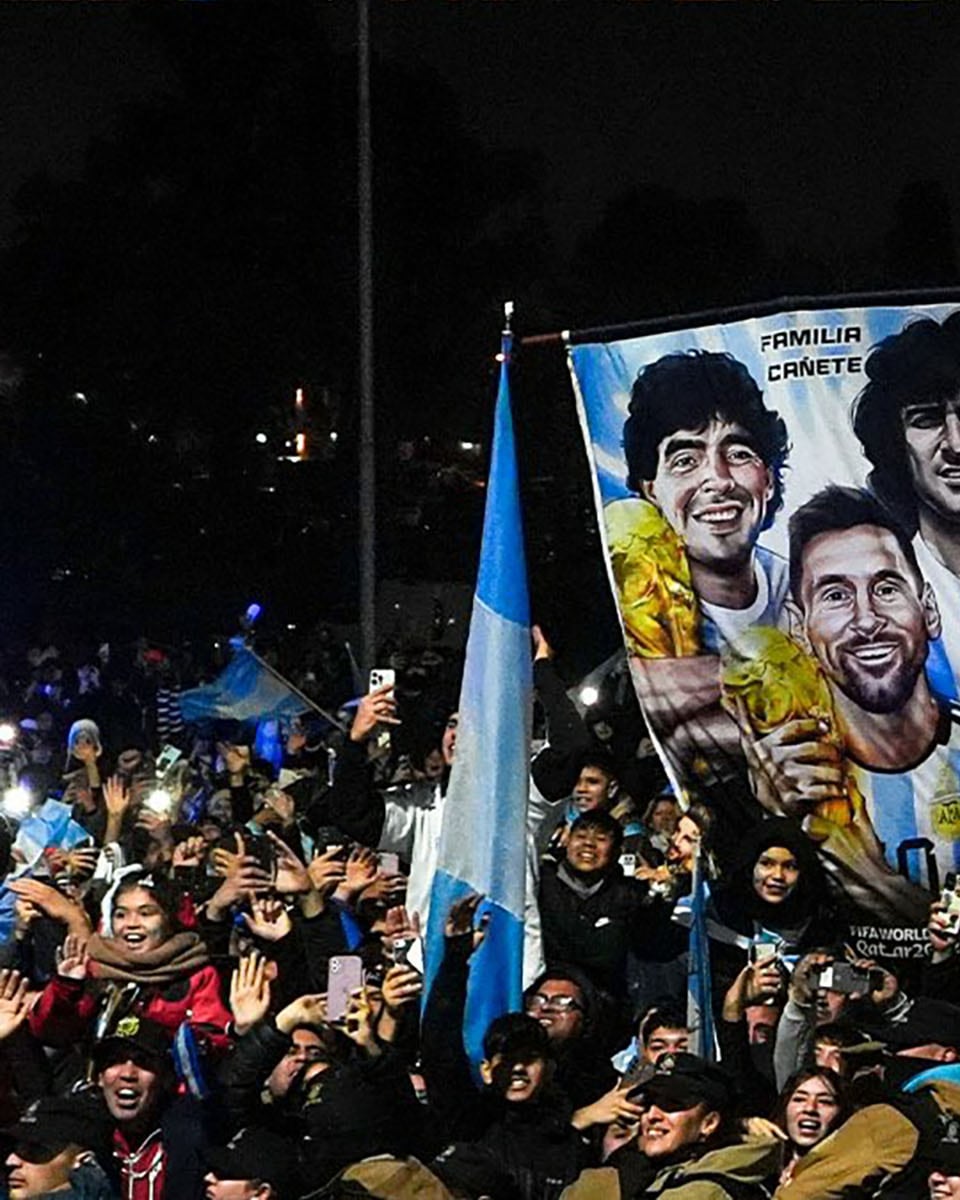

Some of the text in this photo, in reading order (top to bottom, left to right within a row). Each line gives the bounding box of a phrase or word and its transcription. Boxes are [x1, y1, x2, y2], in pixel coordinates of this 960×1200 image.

[761, 326, 861, 353] FAMILIA
[768, 357, 862, 382] CAÑETE
[849, 925, 879, 939] FIFA
